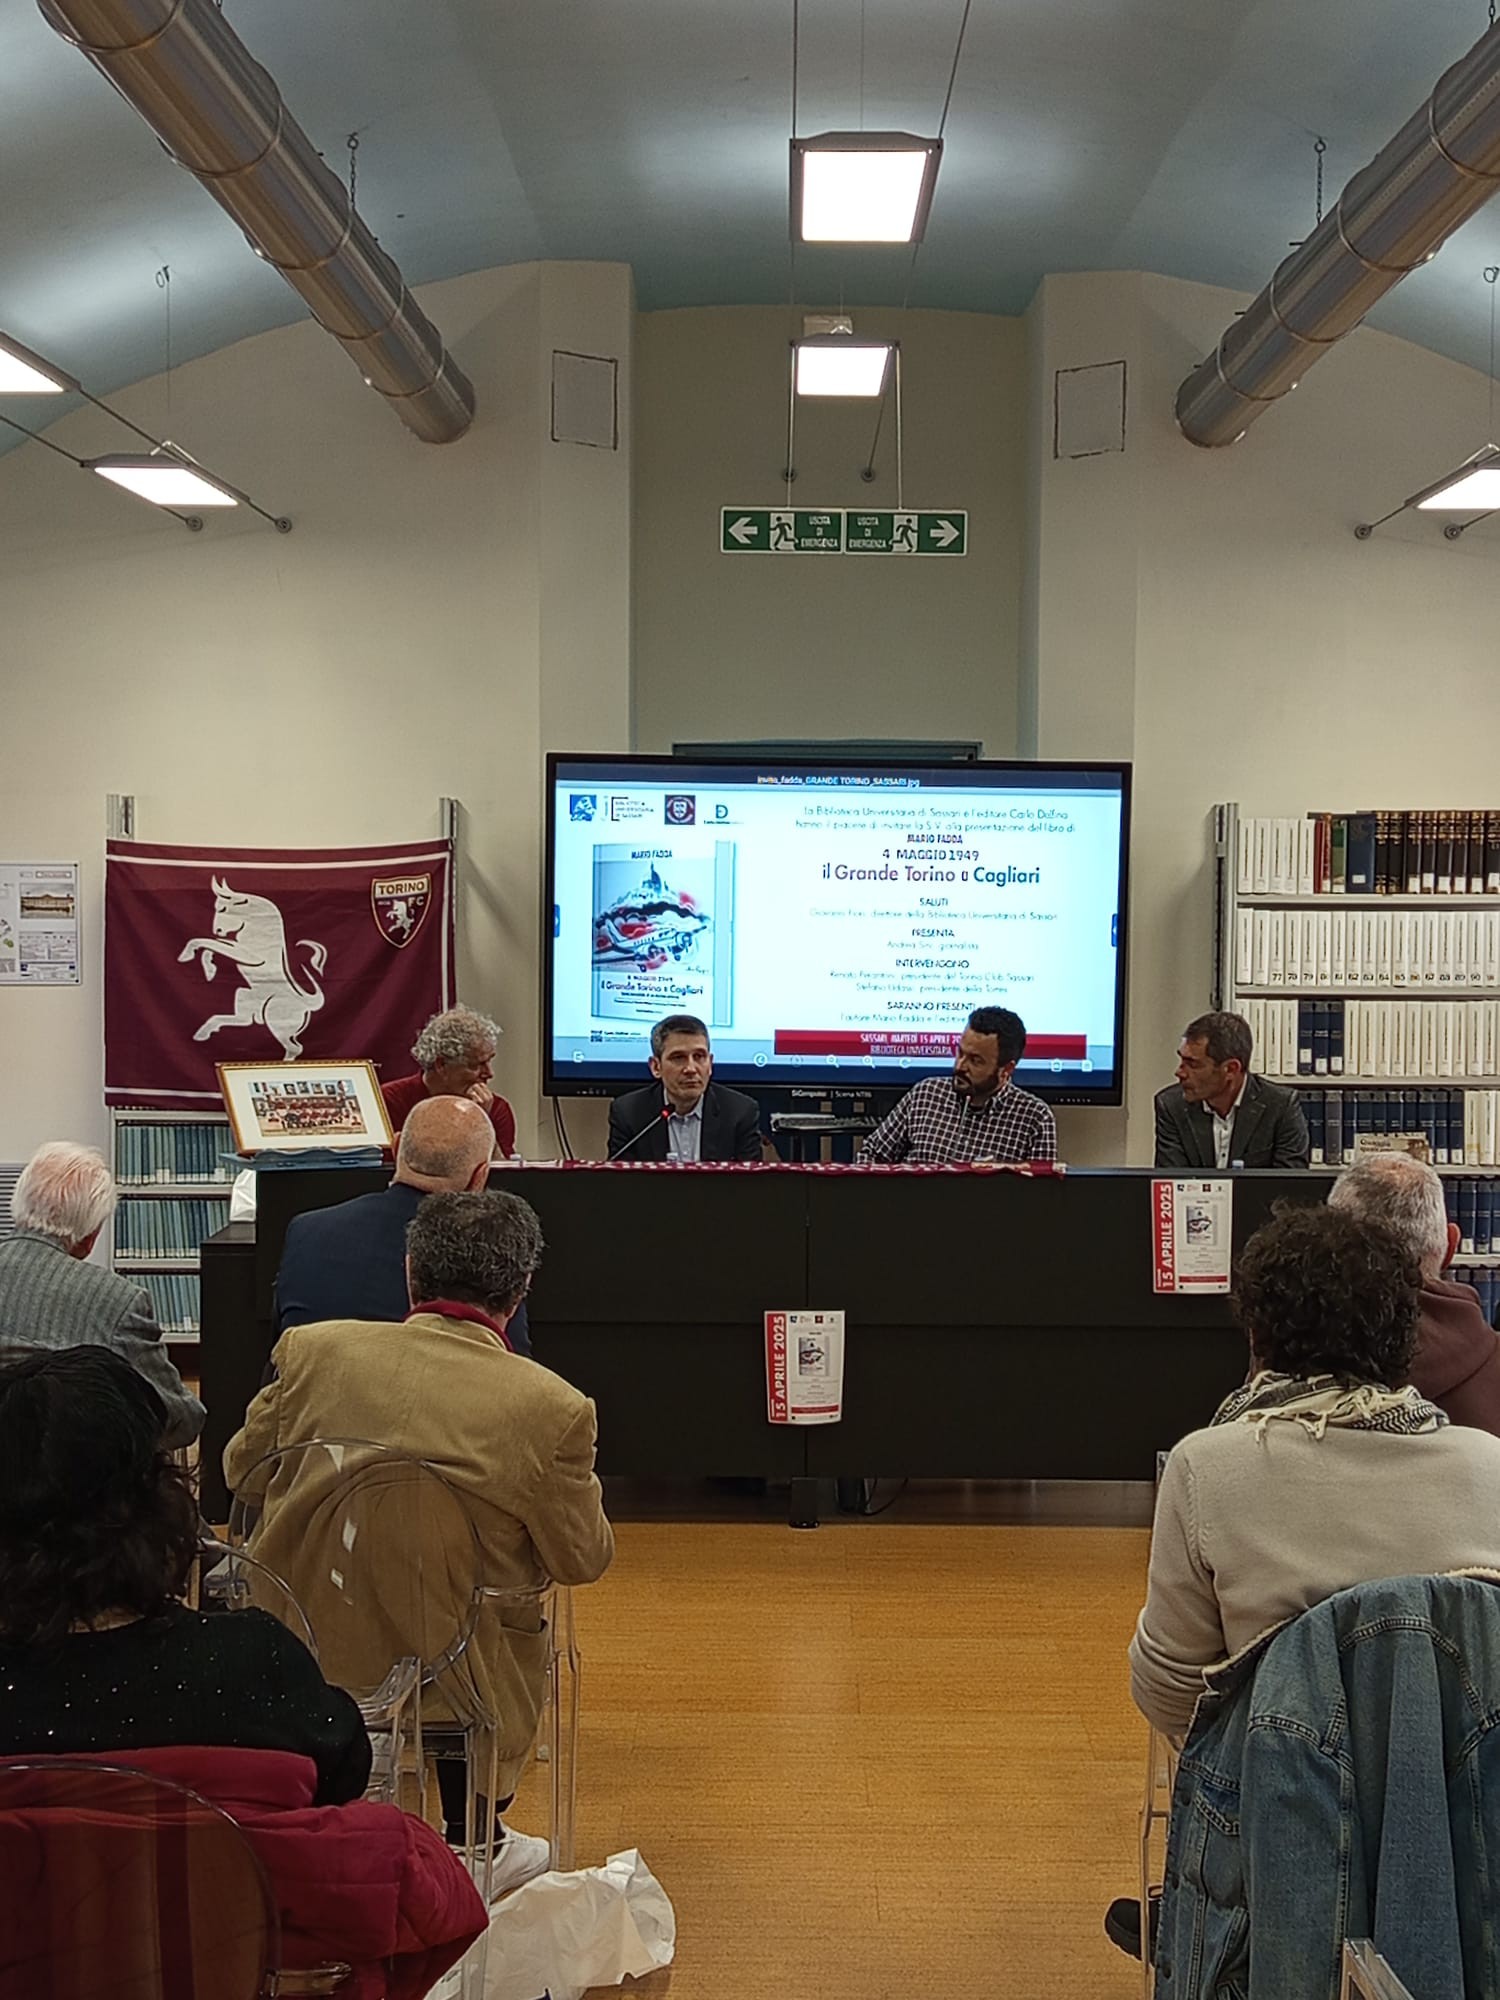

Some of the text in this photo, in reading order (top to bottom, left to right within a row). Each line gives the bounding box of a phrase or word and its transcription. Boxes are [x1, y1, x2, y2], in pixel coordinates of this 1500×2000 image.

[809, 515, 831, 526] USCITA
[857, 516, 879, 527] USCITA
[816, 527, 824, 537] DI
[864, 528, 872, 538] DI
[801, 537, 838, 548] EMERGENZA
[849, 538, 886, 549] EMERGENZA
[907, 834, 963, 844] MARIO FADDA
[882, 849, 979, 861] 4 MAGGIO 1949
[834, 863, 899, 881] Grande
[905, 865, 955, 882] Torino
[973, 865, 1040, 887] Cagliari
[379, 881, 425, 895] TORINO
[919, 898, 949, 906] SALUTI
[912, 928, 955, 937] PRESENTA
[895, 959, 970, 968] INTERVENGONO
[887, 1001, 935, 1010] SARANNO
[870, 1044, 905, 1056] BIBLIOTECA
[1160, 1184, 1173, 1287] 15 APRILE 2025
[773, 1316, 786, 1418] 15 APRILE 2025
